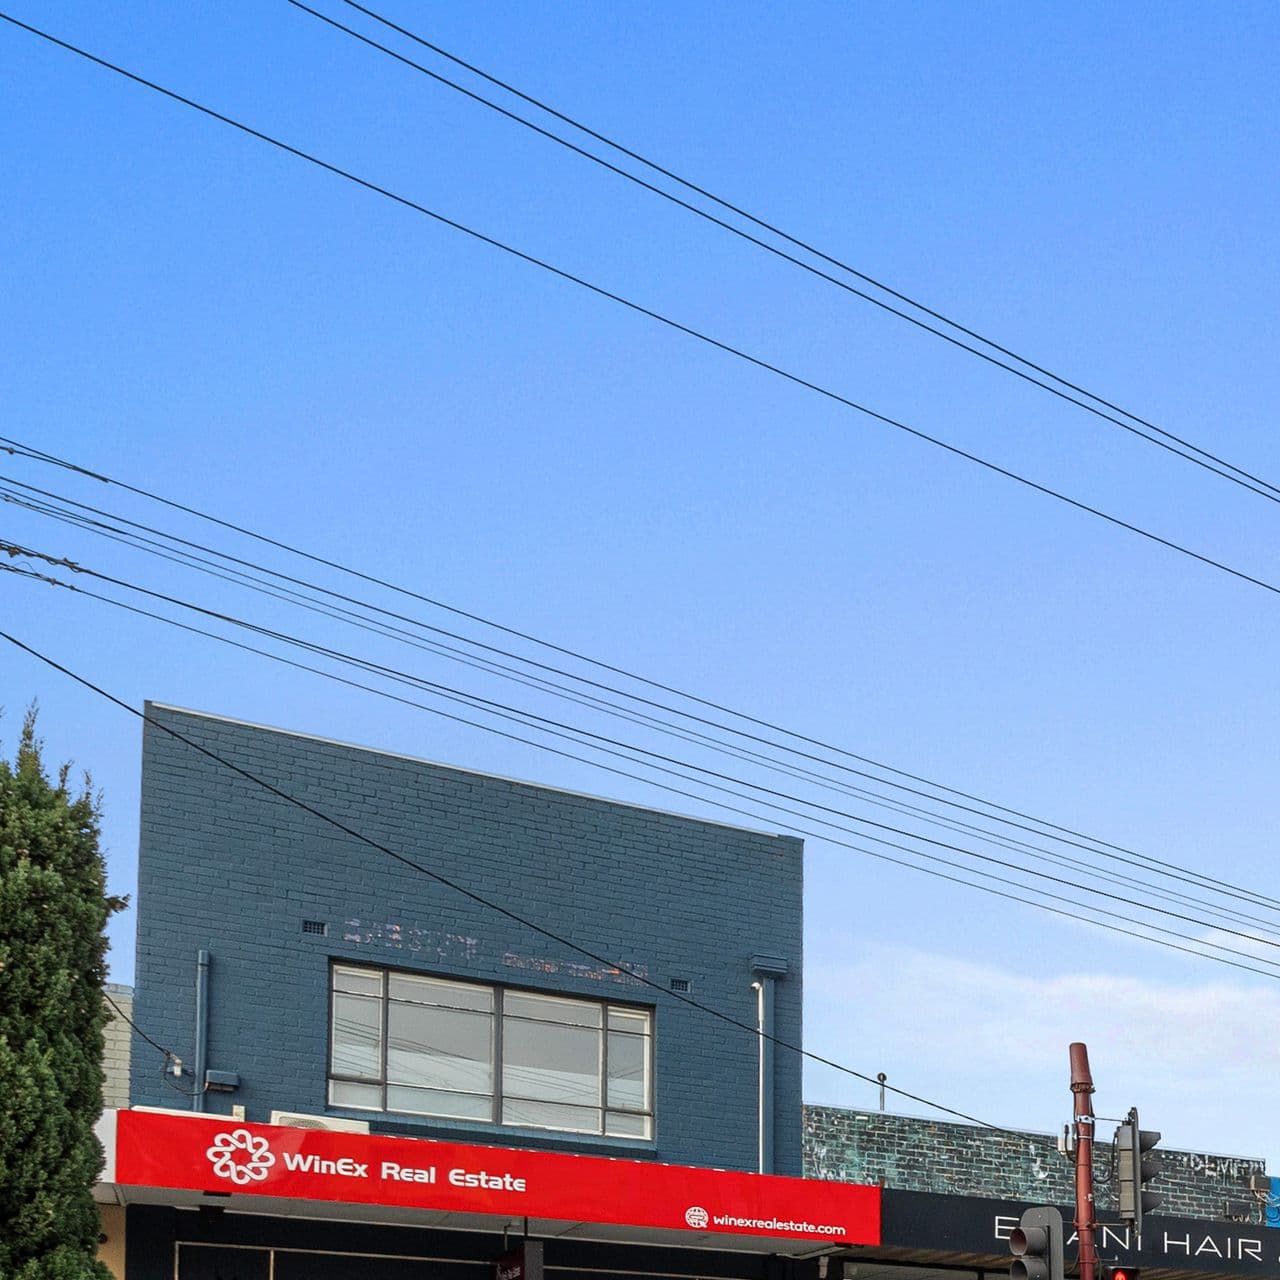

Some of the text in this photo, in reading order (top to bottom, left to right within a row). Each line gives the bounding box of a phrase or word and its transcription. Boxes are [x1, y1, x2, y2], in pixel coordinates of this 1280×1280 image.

[282, 1152, 527, 1192] WinEx Real Estate
[713, 1214, 847, 1236] winexrealestate.com
[1164, 1231, 1264, 1262] HAIR
